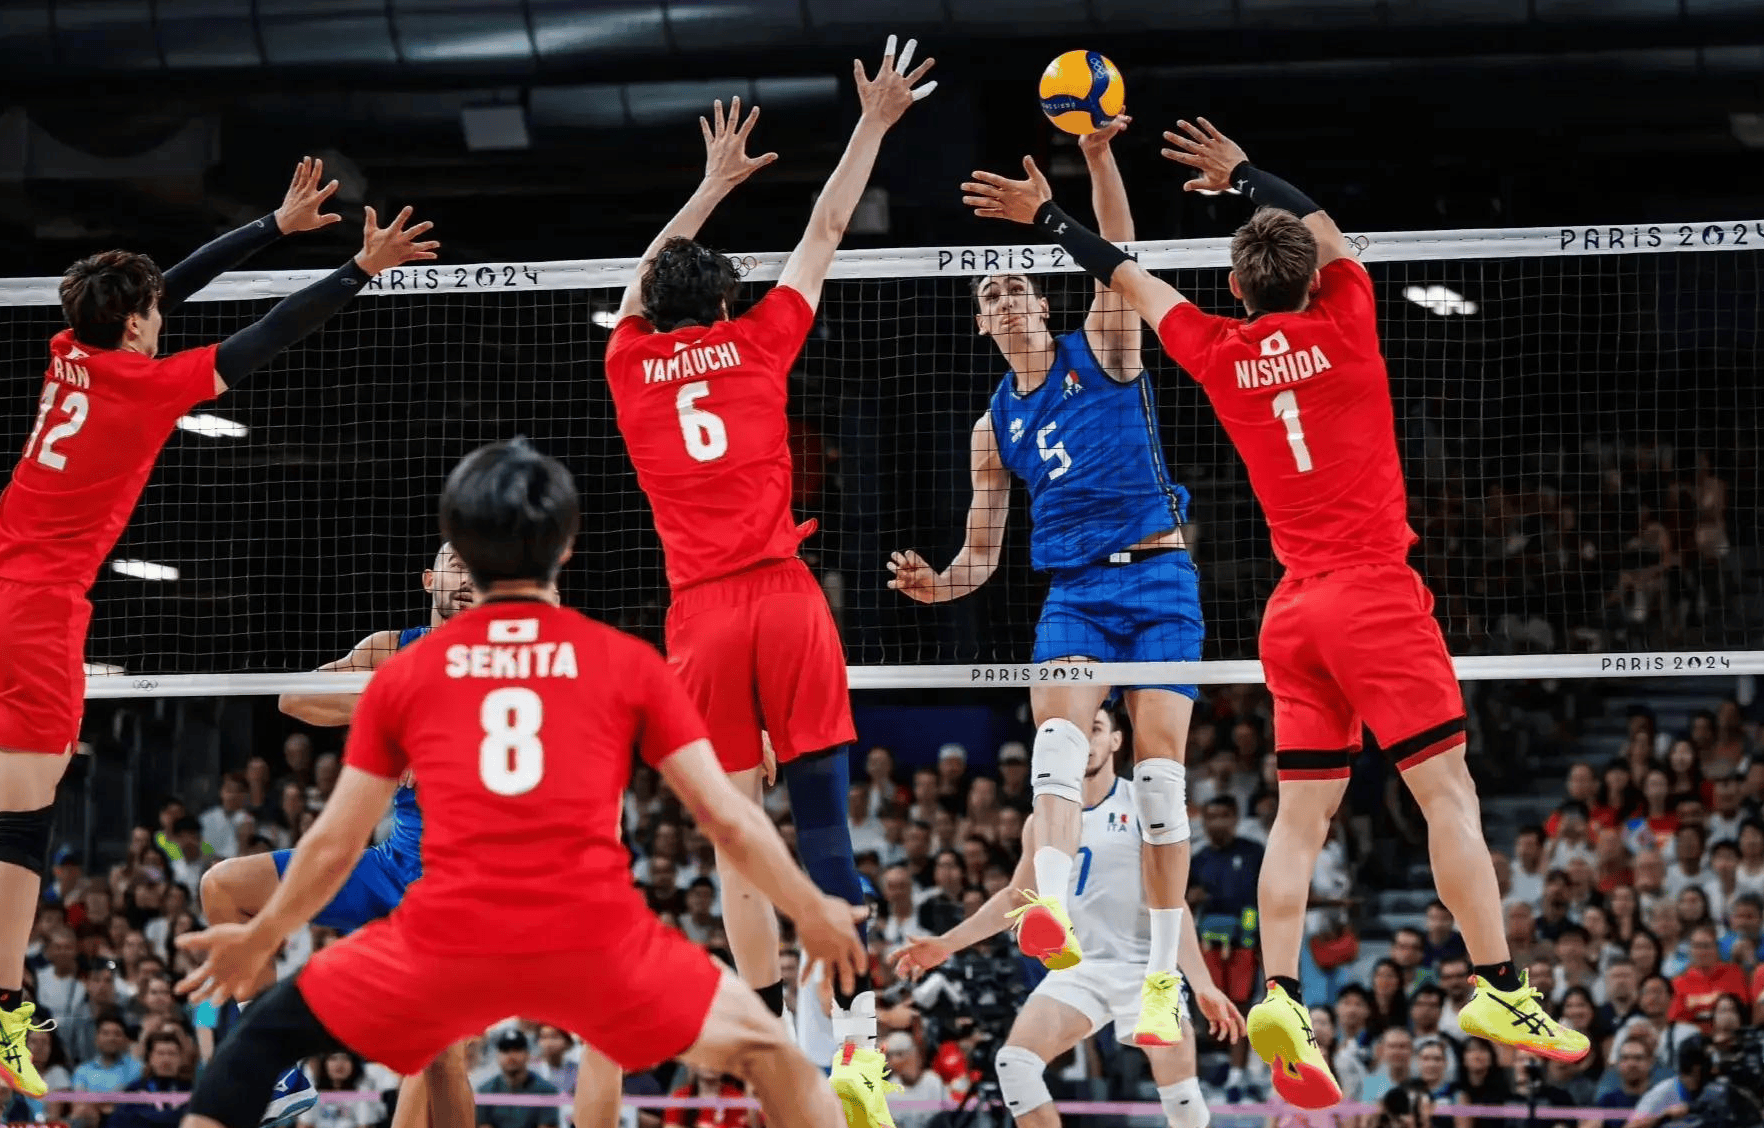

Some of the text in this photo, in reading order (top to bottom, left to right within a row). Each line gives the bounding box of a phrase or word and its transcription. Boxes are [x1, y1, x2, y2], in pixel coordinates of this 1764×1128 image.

[454, 265, 538, 288] 2024
[54, 356, 90, 389] RAN
[642, 341, 741, 384] YAMAUCHI
[1234, 345, 1332, 389] NISHIDA
[24, 381, 89, 471] 12
[676, 380, 729, 462] 6
[1271, 389, 1313, 473] 1
[1036, 420, 1072, 481] 5
[445, 642, 578, 679] SEKITA
[1039, 667, 1093, 681] 2024
[1673, 656, 1730, 670] 2024
[480, 687, 543, 796] 8
[1106, 823, 1128, 833] ITA
